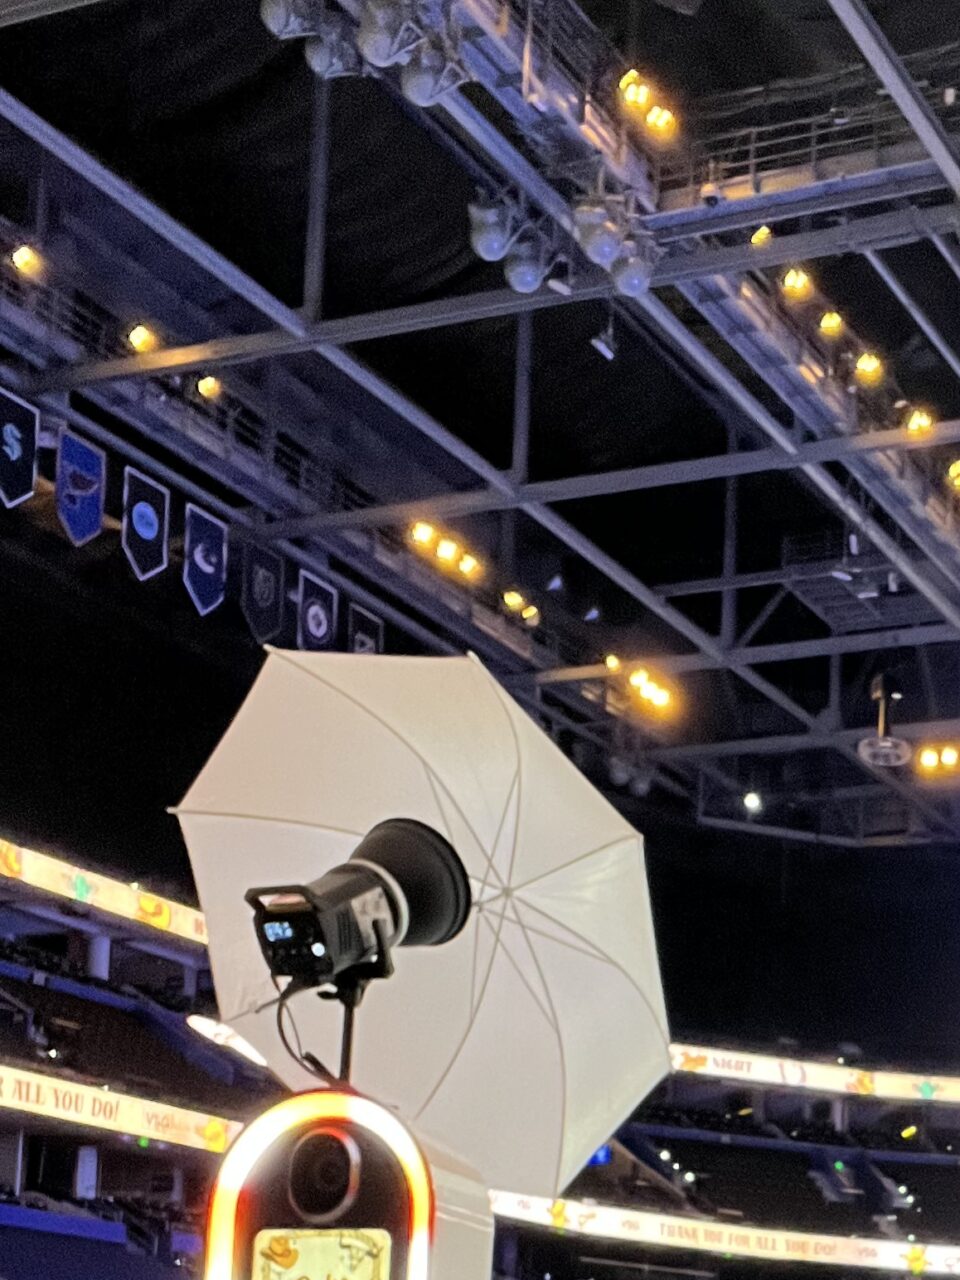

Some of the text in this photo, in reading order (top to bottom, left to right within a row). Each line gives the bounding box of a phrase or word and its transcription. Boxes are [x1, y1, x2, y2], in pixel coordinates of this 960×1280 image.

[12, 1078, 46, 1106] ALL
[53, 1086, 85, 1113] YOU
[91, 1096, 121, 1123] DO!
[755, 1236, 778, 1251] ALL
